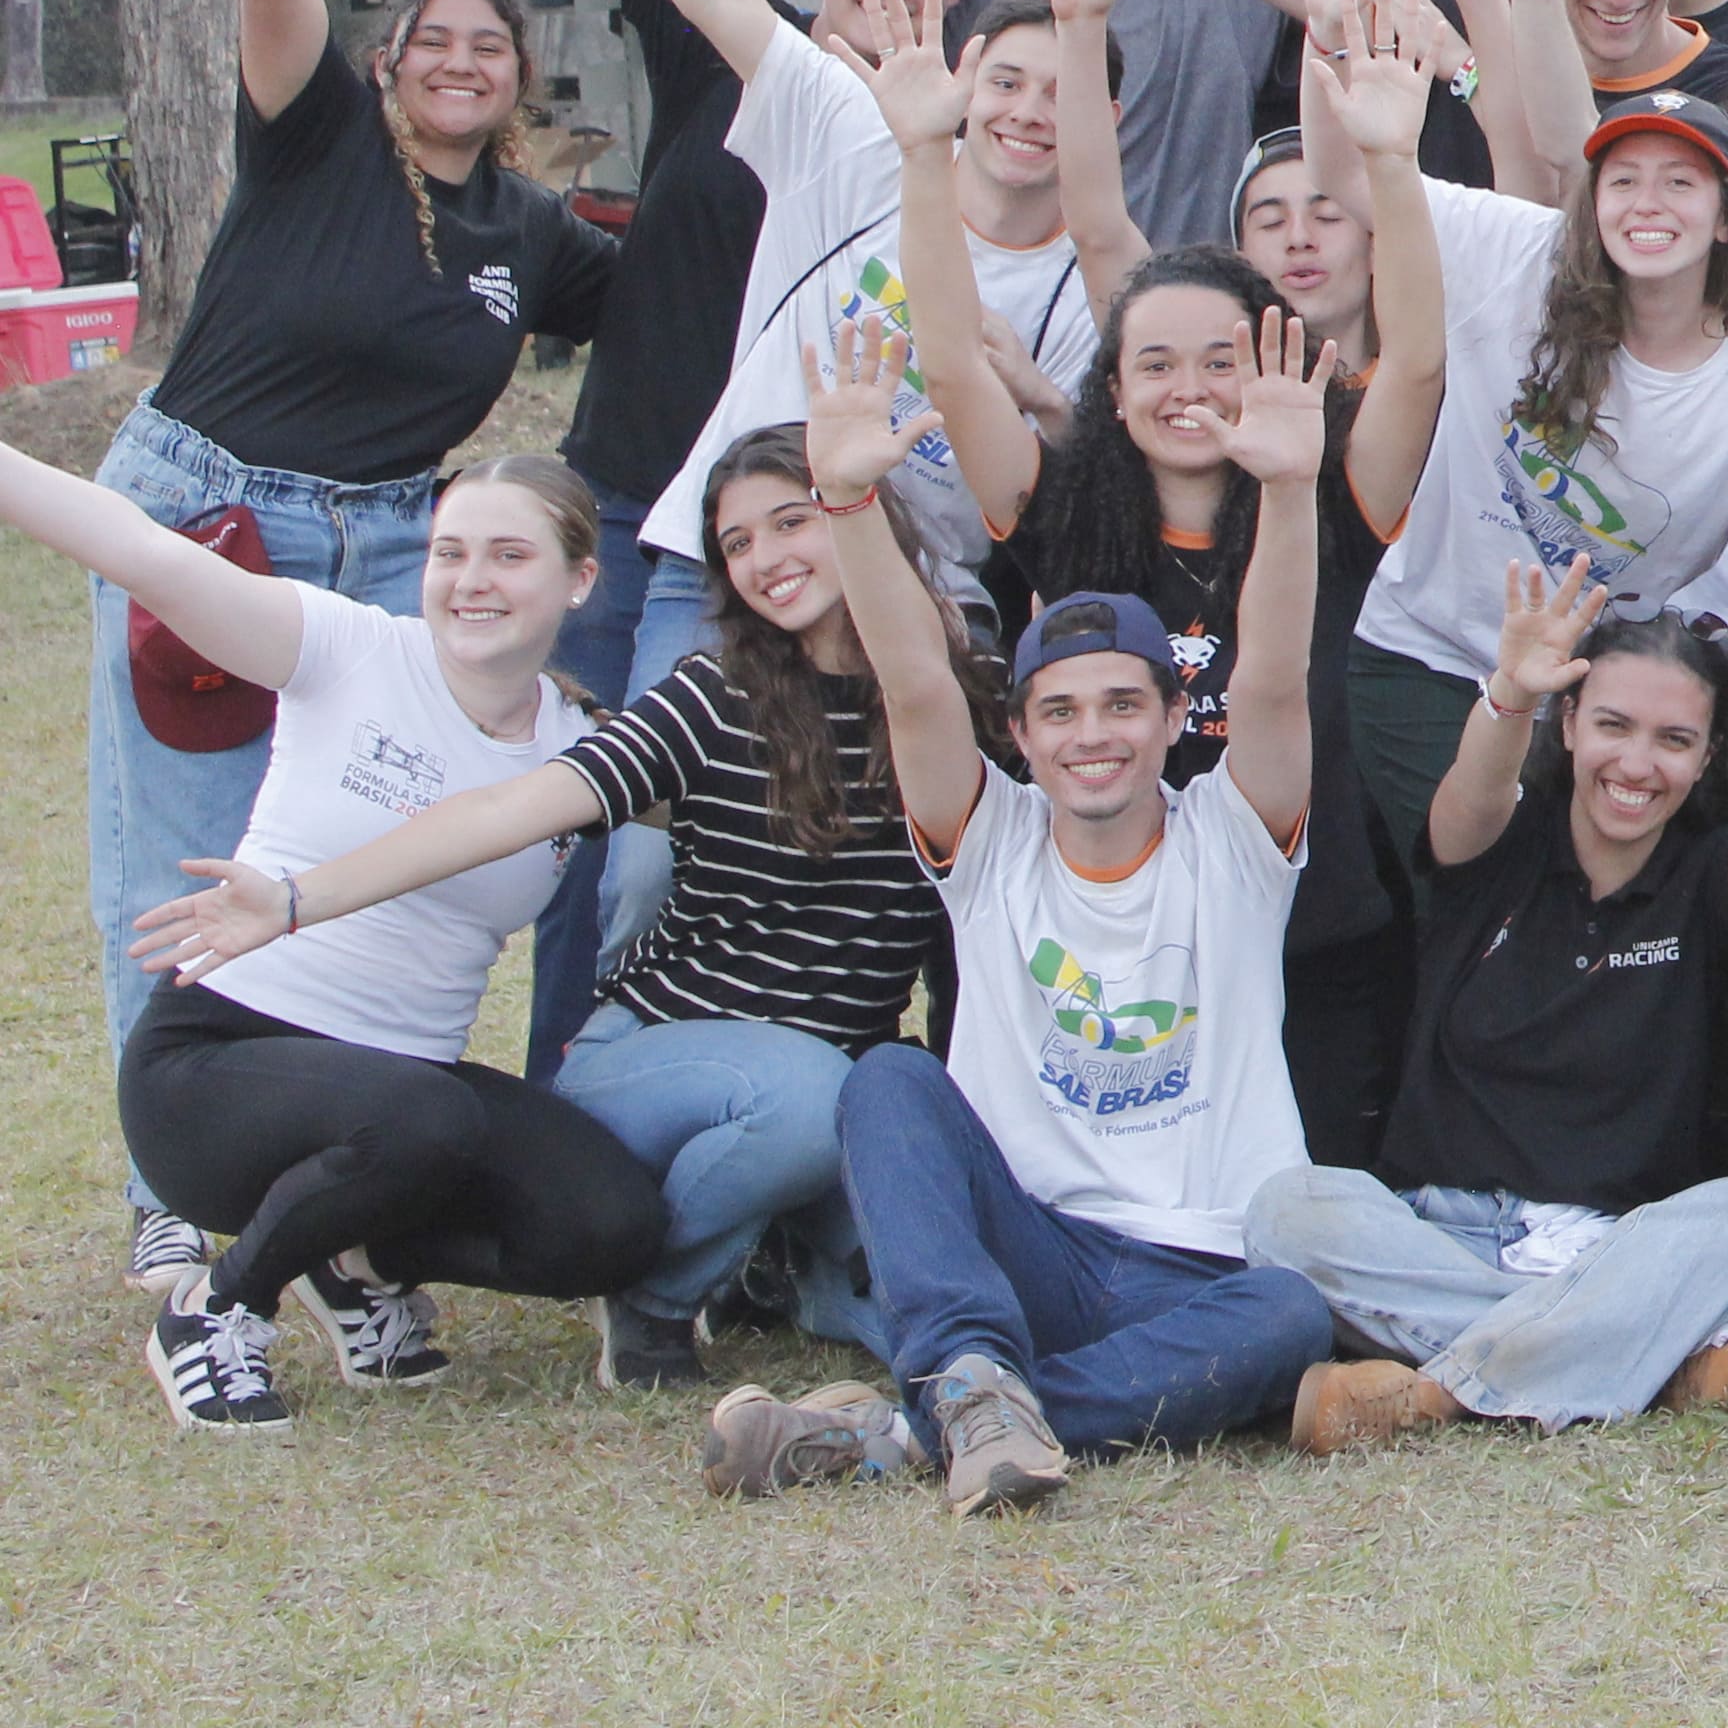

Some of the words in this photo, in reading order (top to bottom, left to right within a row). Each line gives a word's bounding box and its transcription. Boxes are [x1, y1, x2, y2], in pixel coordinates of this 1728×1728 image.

[482, 264, 511, 279] ANTI
[344, 762, 410, 800] FORMULA
[340, 775, 393, 811] BRASIL
[1632, 936, 1679, 952] UNICAMP
[1608, 946, 1680, 968] RACING
[1039, 1062, 1091, 1108] SAE
[1105, 1121, 1158, 1138] Fórmula
